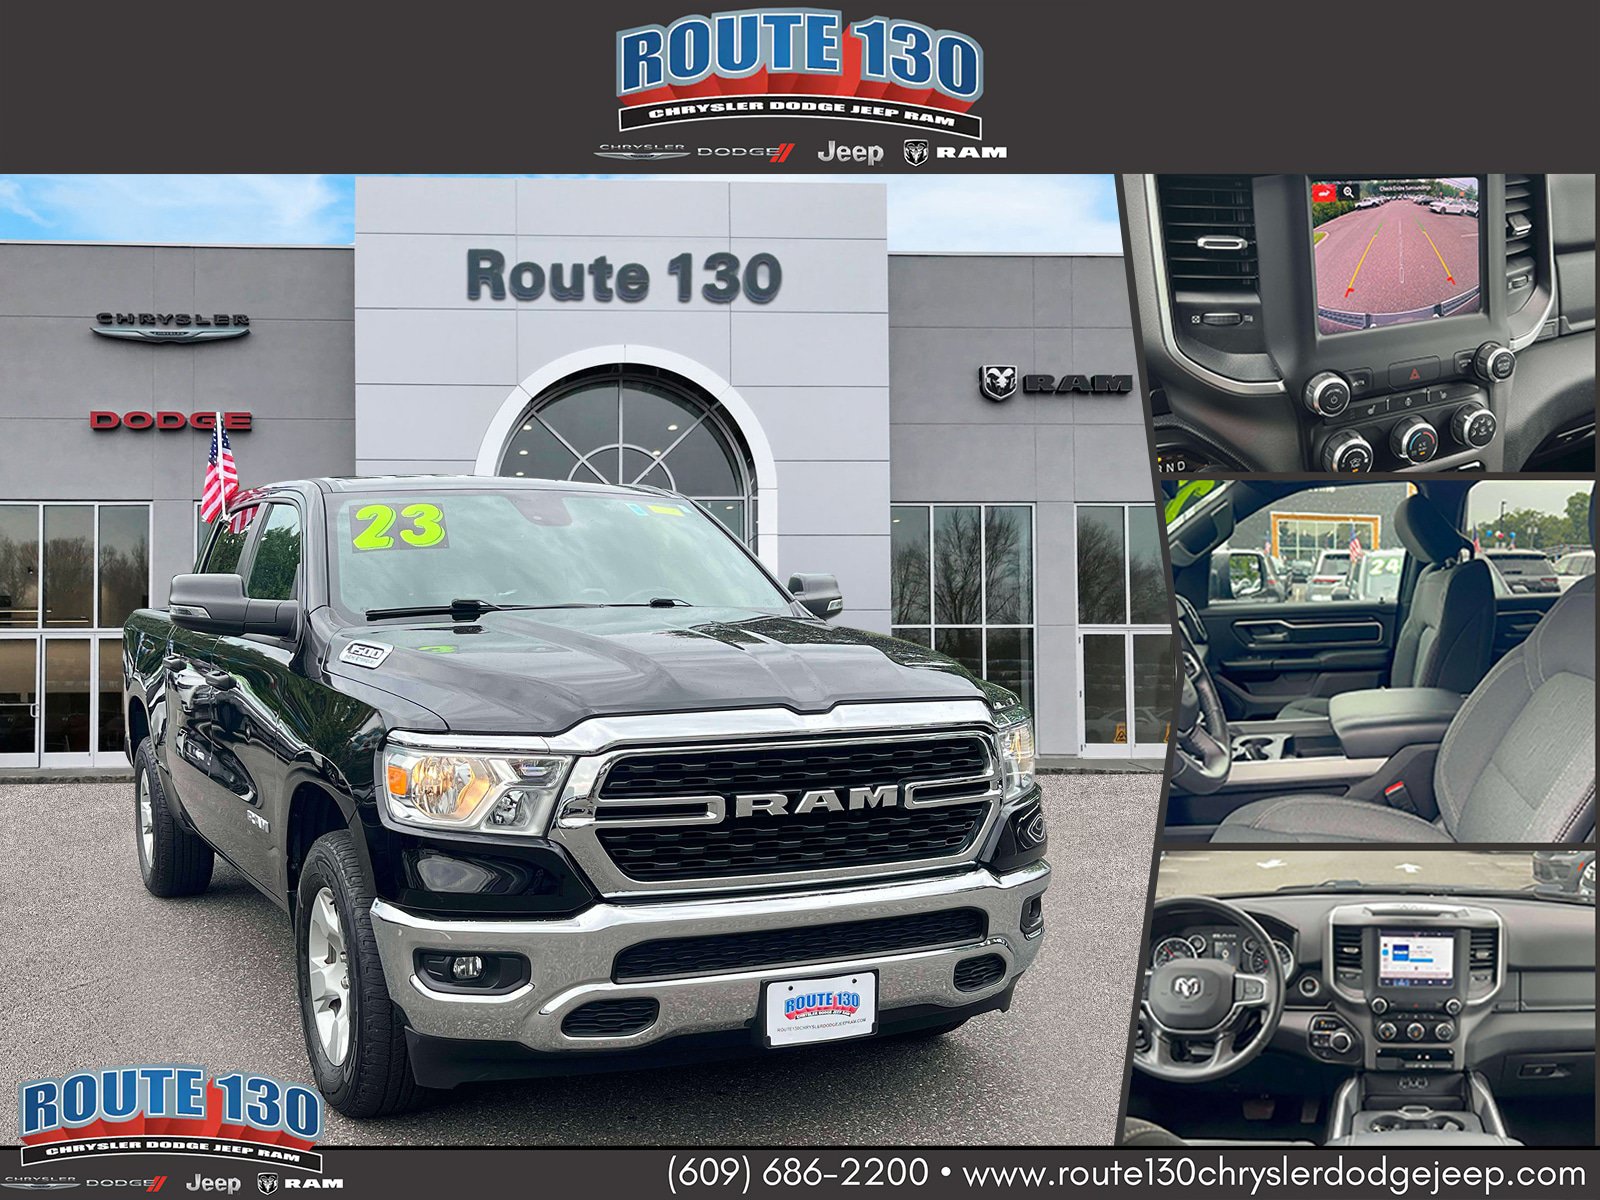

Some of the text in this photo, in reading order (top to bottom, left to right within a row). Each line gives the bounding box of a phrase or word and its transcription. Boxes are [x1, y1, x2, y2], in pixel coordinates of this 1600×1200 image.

[467, 248, 783, 305] Route 130
[96, 312, 250, 327] CHRYSLER
[1022, 374, 1134, 395] RAM
[90, 410, 252, 431] DODGE
[352, 503, 447, 551] 23
[1369, 557, 1401, 576] 24
[735, 784, 899, 818] RAM
[784, 990, 861, 1014] ROUTE 130
